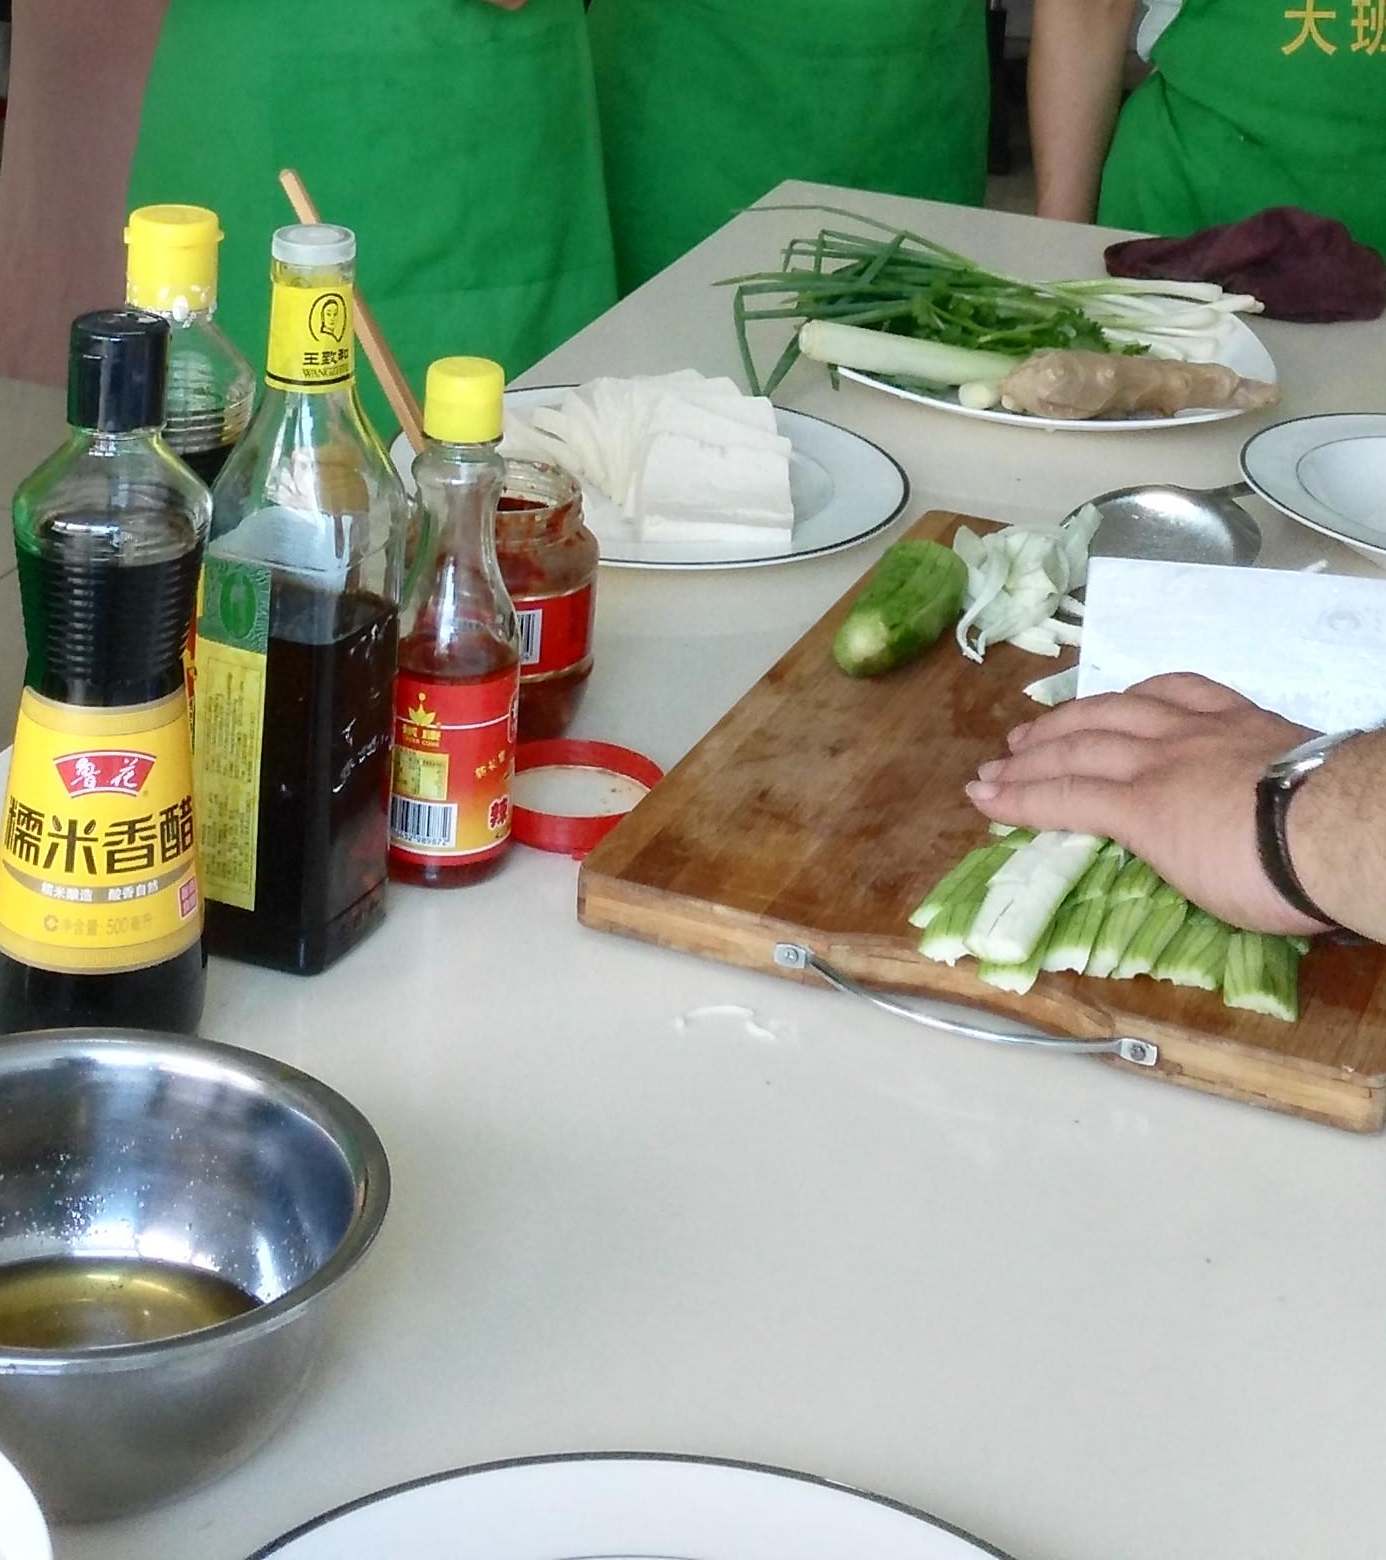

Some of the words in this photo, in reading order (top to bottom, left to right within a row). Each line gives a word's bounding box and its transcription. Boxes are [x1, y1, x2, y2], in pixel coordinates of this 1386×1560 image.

[302, 348, 349, 366] 王致和
[70, 756, 139, 790] 鲁花
[3, 794, 195, 876] 糯米香醋
